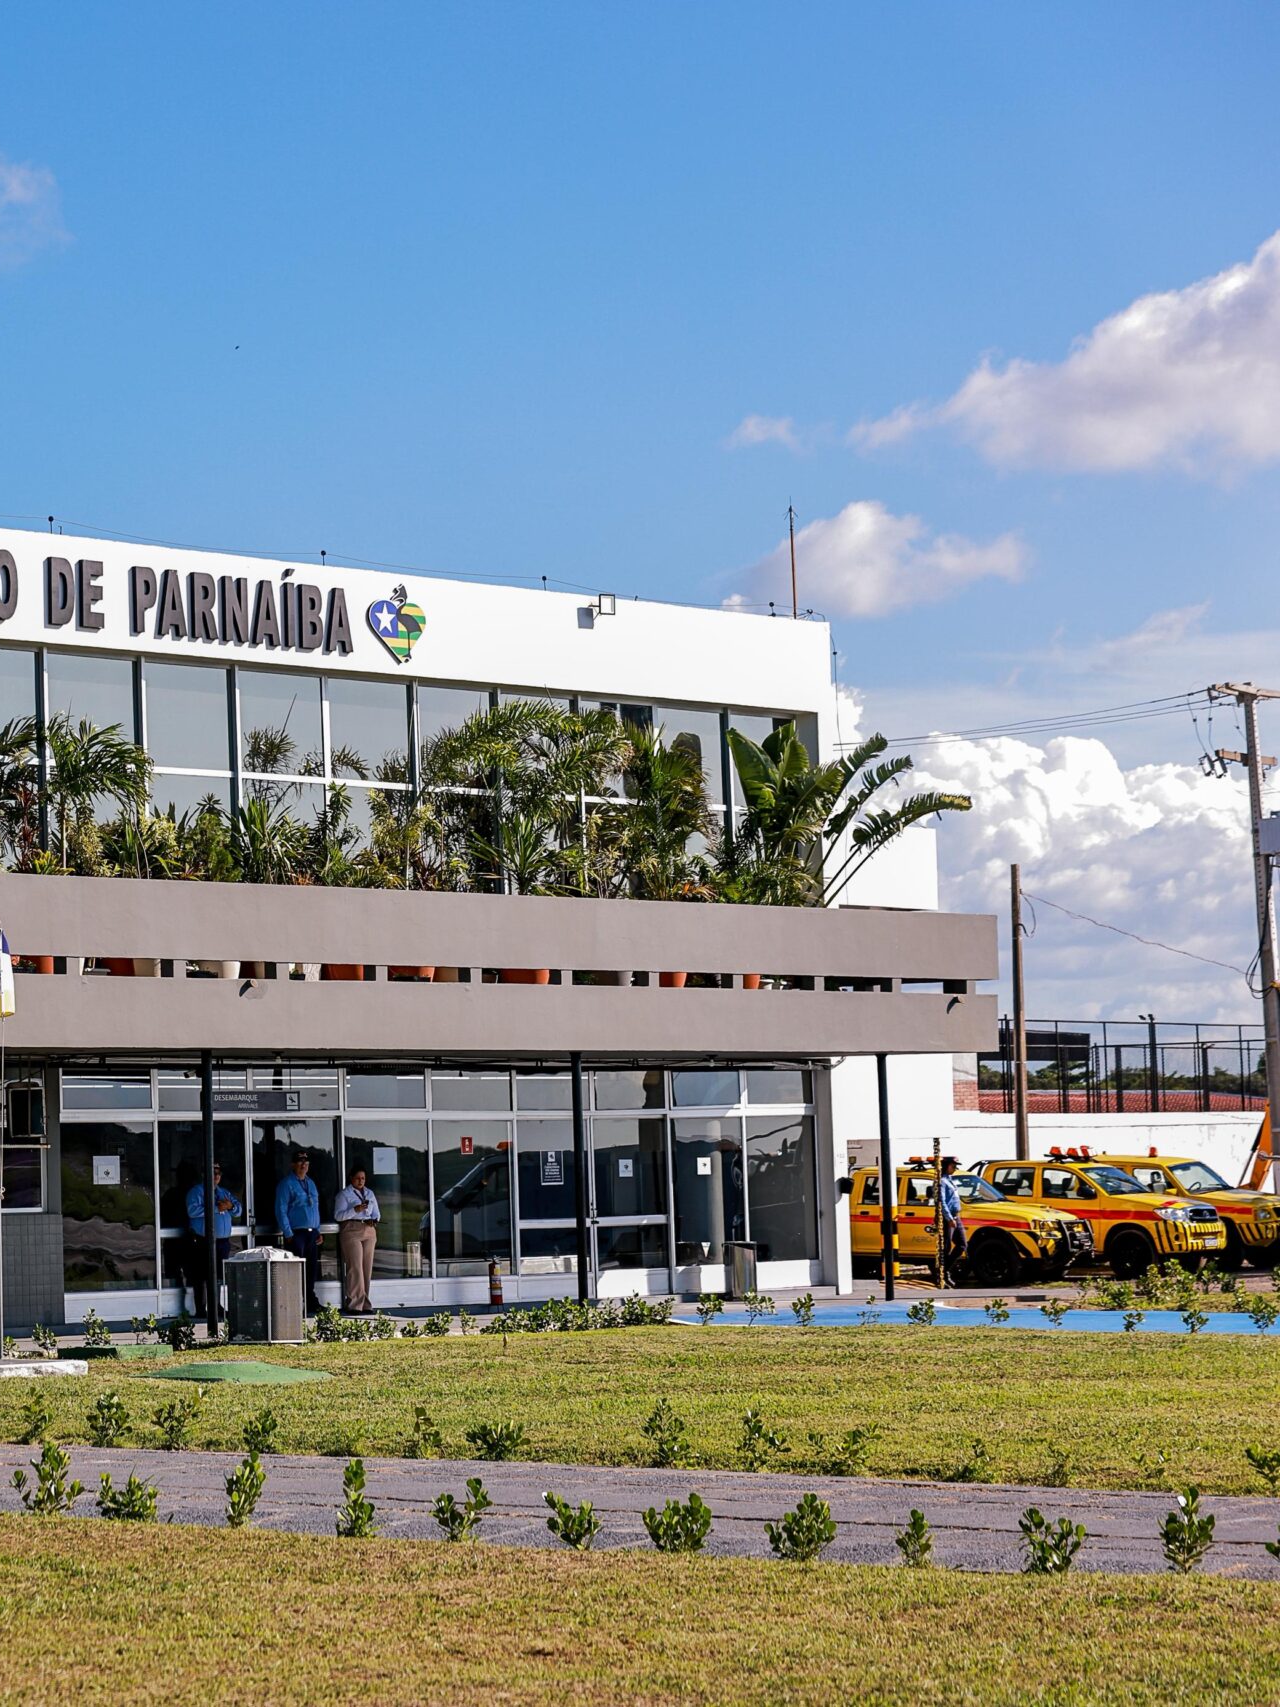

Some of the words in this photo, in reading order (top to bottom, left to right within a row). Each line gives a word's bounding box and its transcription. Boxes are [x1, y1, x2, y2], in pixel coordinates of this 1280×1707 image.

[43, 556, 105, 632] DE
[129, 566, 354, 655] PARNAÍBA
[214, 1094, 258, 1102] DESEMBARQUE
